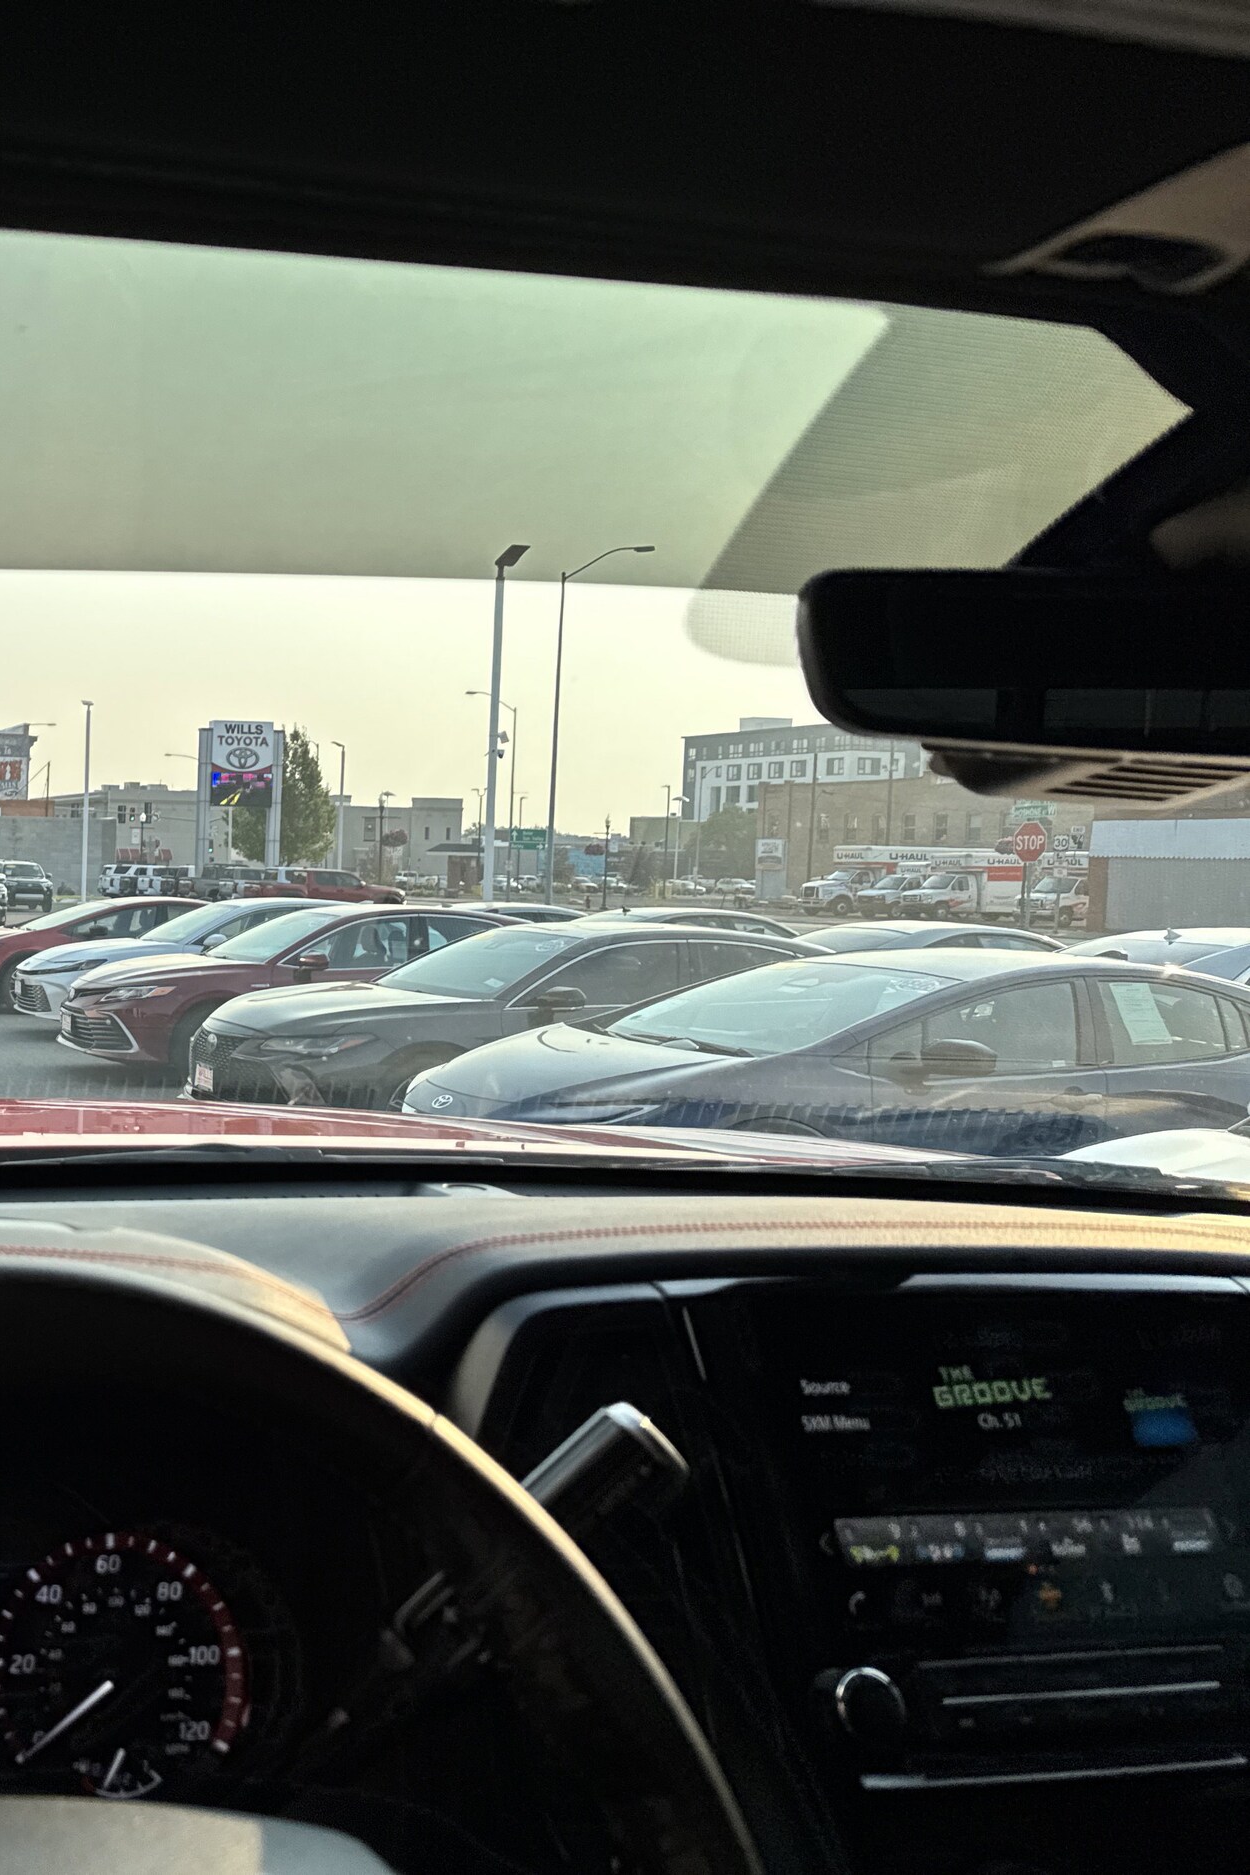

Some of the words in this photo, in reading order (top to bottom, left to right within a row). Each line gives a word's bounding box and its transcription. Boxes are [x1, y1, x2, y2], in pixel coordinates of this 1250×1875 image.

[225, 724, 264, 735] WILLS
[217, 735, 269, 747] TOYOTA
[1016, 835, 1044, 850] STOP
[1055, 838, 1068, 847] 30
[799, 1378, 851, 1396] Source
[932, 1375, 1053, 1409] GROOVE
[95, 1554, 121, 1574] 60
[35, 1584, 63, 1604] 40
[156, 1581, 183, 1601] 80
[9, 1654, 36, 1674] 20
[189, 1645, 220, 1665] 100
[179, 1721, 211, 1741] 120
